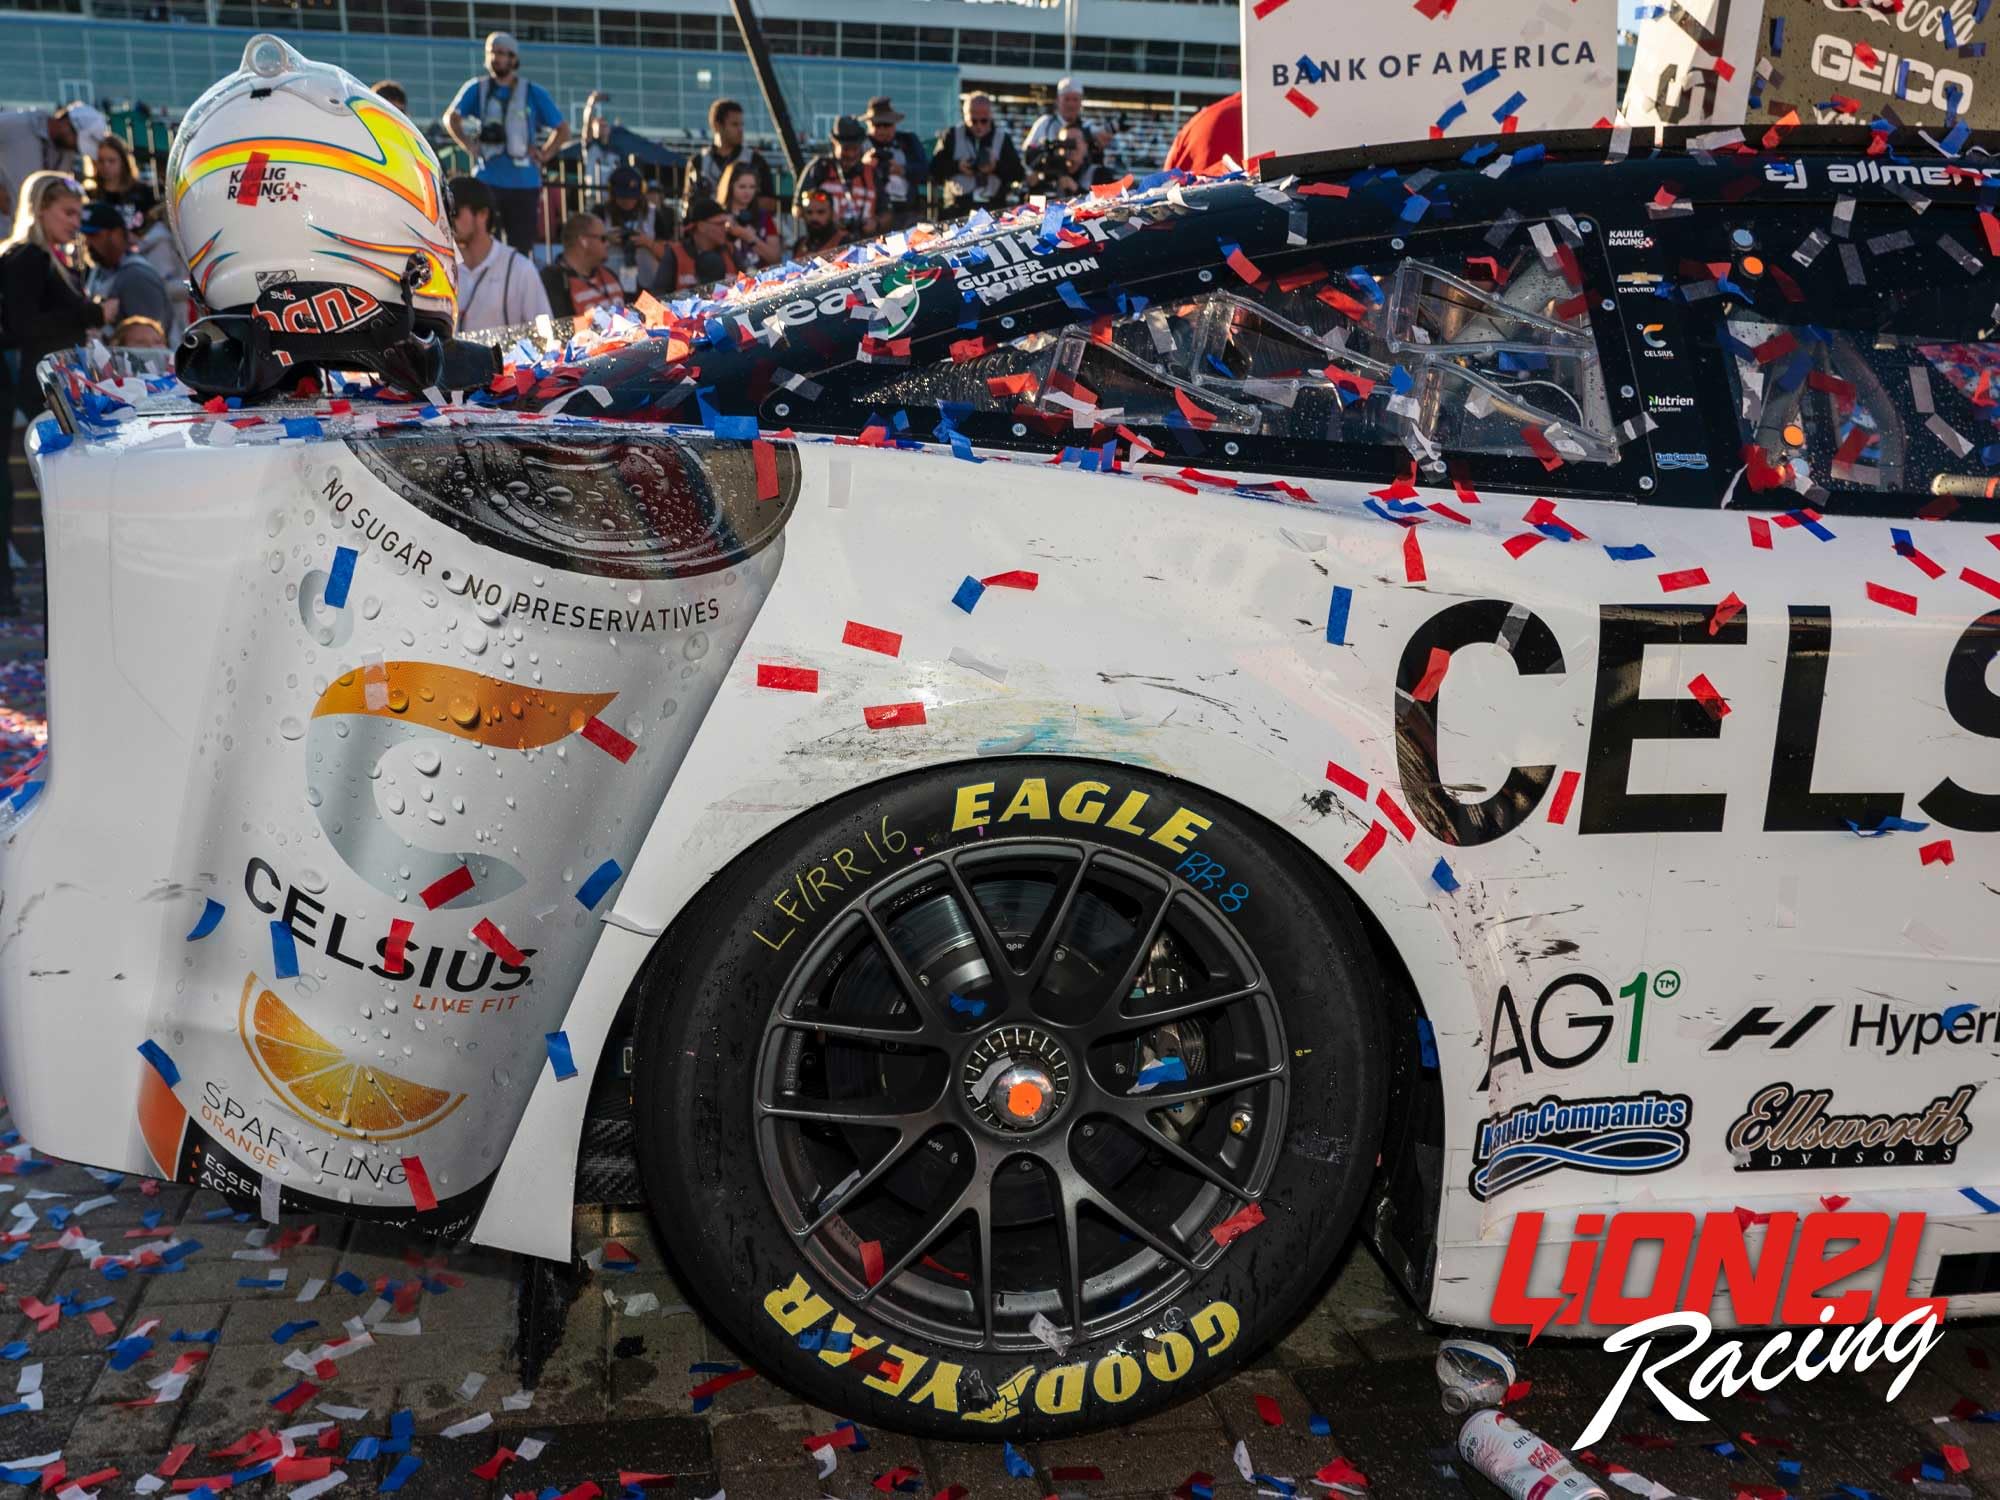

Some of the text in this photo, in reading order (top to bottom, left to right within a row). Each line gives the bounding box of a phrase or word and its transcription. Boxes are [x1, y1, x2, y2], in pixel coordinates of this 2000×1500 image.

[1272, 40, 1597, 86] BANK OF AMERICA
[1811, 34, 1974, 115] GEICO
[227, 182, 286, 200] RING
[229, 167, 287, 185] KLIG
[1608, 238, 1645, 247] RACING
[1609, 230, 1644, 238] KAULIG
[957, 259, 1045, 291] GUTTER
[961, 256, 1100, 307] PROTECTION
[733, 272, 882, 338] Leaf
[1648, 395, 1694, 406] Nutrien
[321, 477, 721, 633] NO SUGAR NO PRESERVATIVES
[1394, 598, 2000, 847] CELS
[951, 777, 1212, 855] EAGLE
[244, 857, 539, 992] CELSIUS
[412, 994, 520, 1014] LIVE FIT
[1476, 970, 1648, 1093] AG1
[202, 1105, 280, 1171] ORANGE
[1731, 1085, 1971, 1151] Ellsworth
[204, 1153, 263, 1198] ESSEN
[1513, 1432, 1535, 1449] CEL
